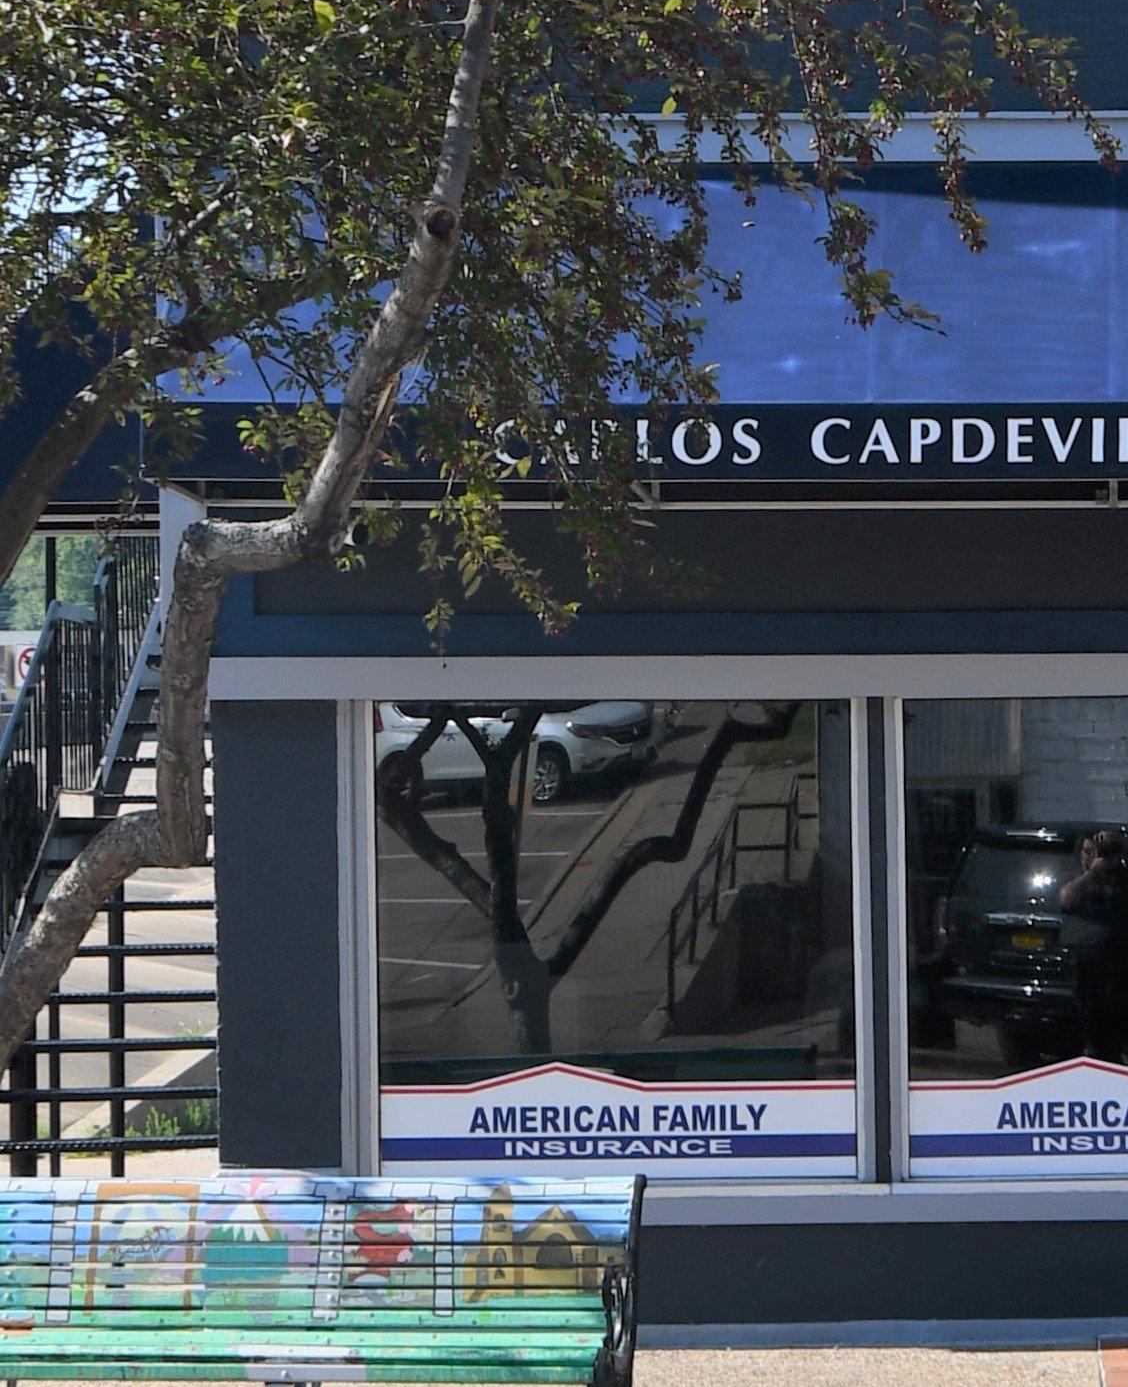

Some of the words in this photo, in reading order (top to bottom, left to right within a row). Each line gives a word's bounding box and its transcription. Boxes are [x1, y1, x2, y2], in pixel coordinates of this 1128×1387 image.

[468, 1104, 640, 1133] AMERICAN
[652, 1103, 767, 1132] FAMILY
[503, 1138, 733, 1157] INSURANCE
